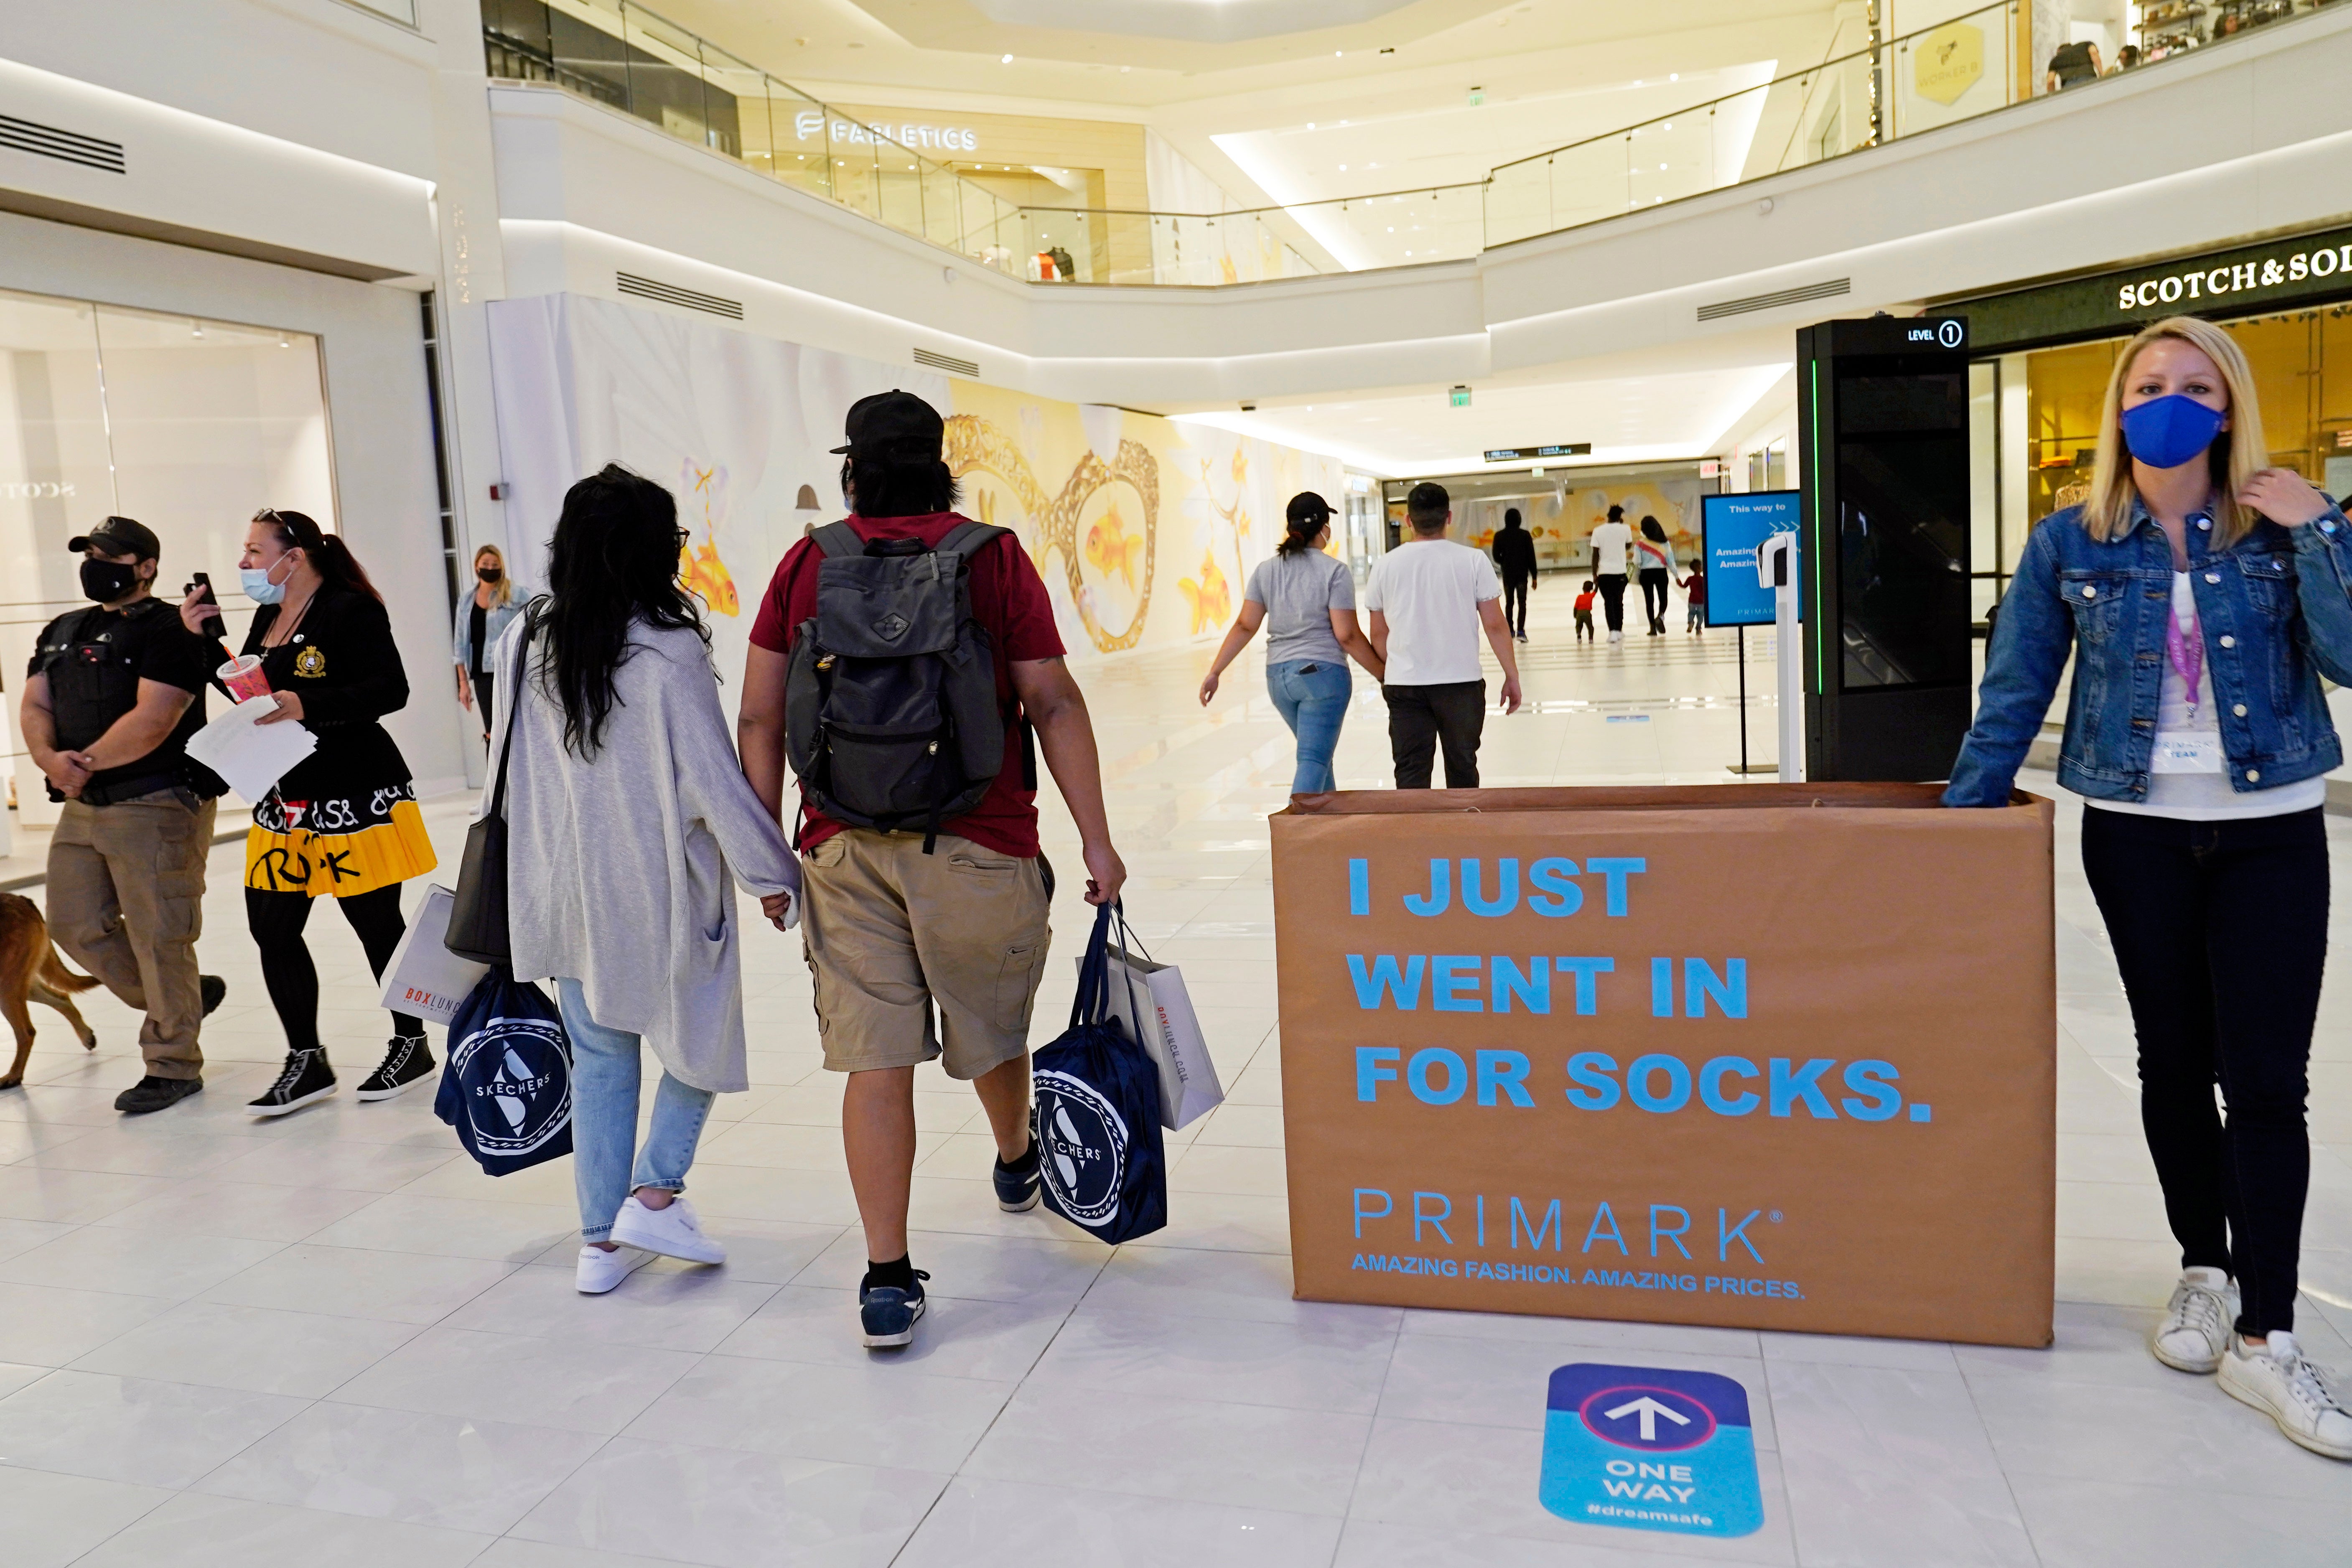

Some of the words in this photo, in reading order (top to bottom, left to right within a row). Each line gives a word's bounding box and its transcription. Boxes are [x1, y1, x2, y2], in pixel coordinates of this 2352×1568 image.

[831, 121, 977, 150] FABLETICS
[1908, 329, 1934, 341] LEVEL
[1729, 505, 1750, 513] This
[1349, 858, 1369, 915] I
[1403, 857, 1647, 917] JUST
[1346, 954, 1615, 1016] WENT
[1652, 957, 1748, 1019] IN
[405, 988, 461, 1013] BOXLUNC
[476, 1072, 551, 1096] SKECHERS
[1355, 1046, 1535, 1107] FOR
[1565, 1051, 1931, 1123] SOCKS.
[1352, 1254, 1458, 1277] AMAZING
[1465, 1261, 1576, 1283] FASHION.
[1582, 1269, 1697, 1291] AMAZING
[1705, 1276, 1805, 1299] PRICES.
[1606, 1460, 1692, 1483] ONE
[1602, 1479, 1695, 1504] WAY
[1588, 1504, 1713, 1526] #dreamsafe
